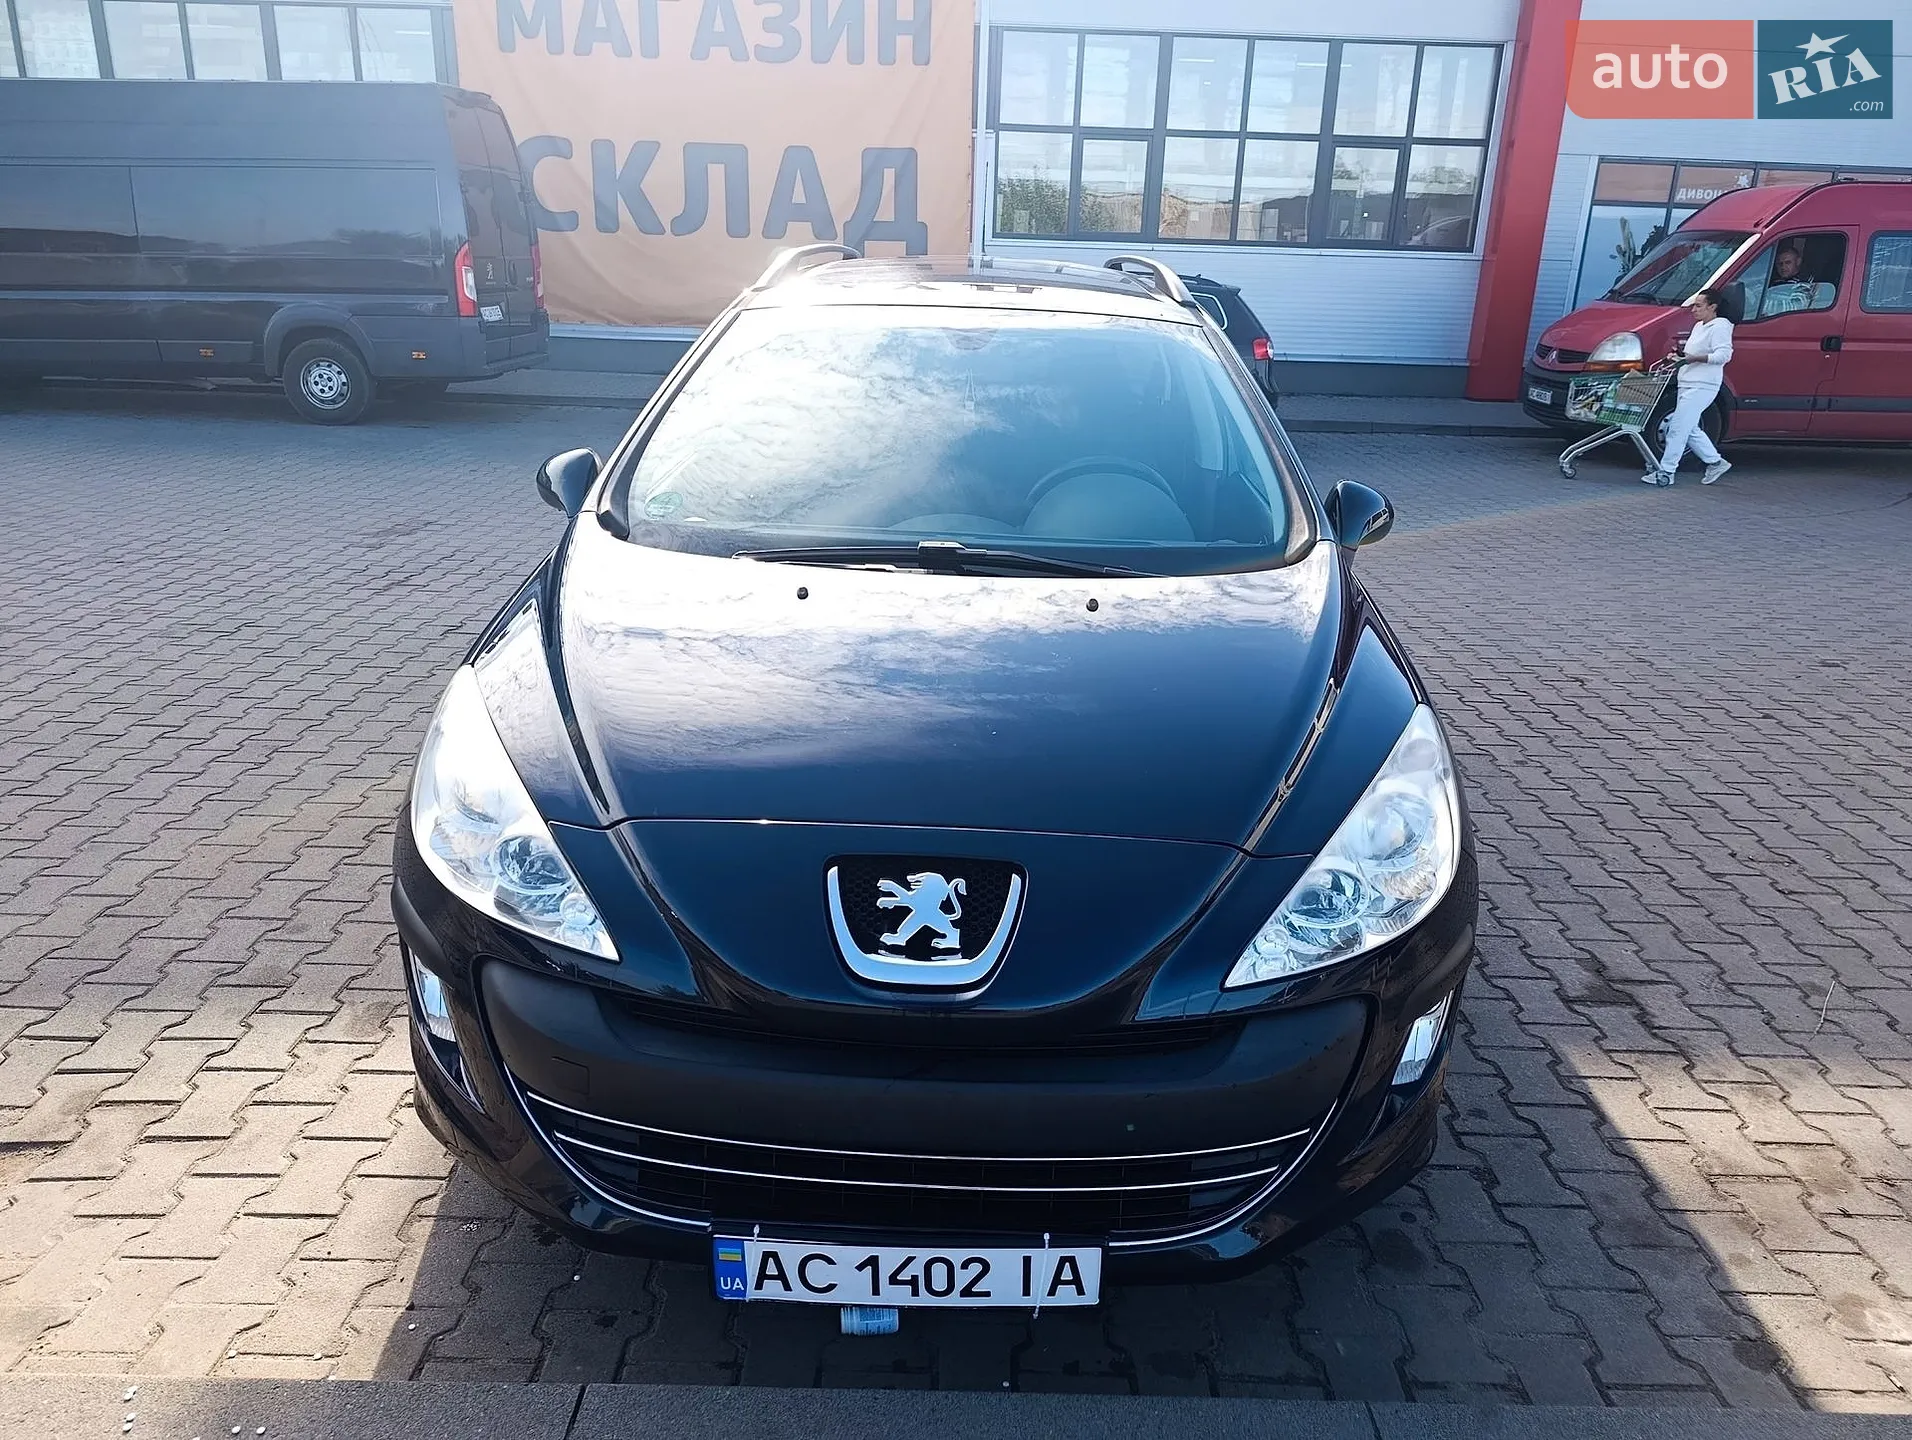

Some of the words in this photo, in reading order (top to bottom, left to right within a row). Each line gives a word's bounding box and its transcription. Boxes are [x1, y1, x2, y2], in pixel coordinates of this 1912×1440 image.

[496, 0, 932, 66] МАГАЗИН
[516, 134, 929, 260] СКЛАД
[720, 1276, 745, 1292] UA
[754, 1250, 839, 1294] AC
[855, 1254, 992, 1298] 1402
[1021, 1254, 1087, 1297] IA
